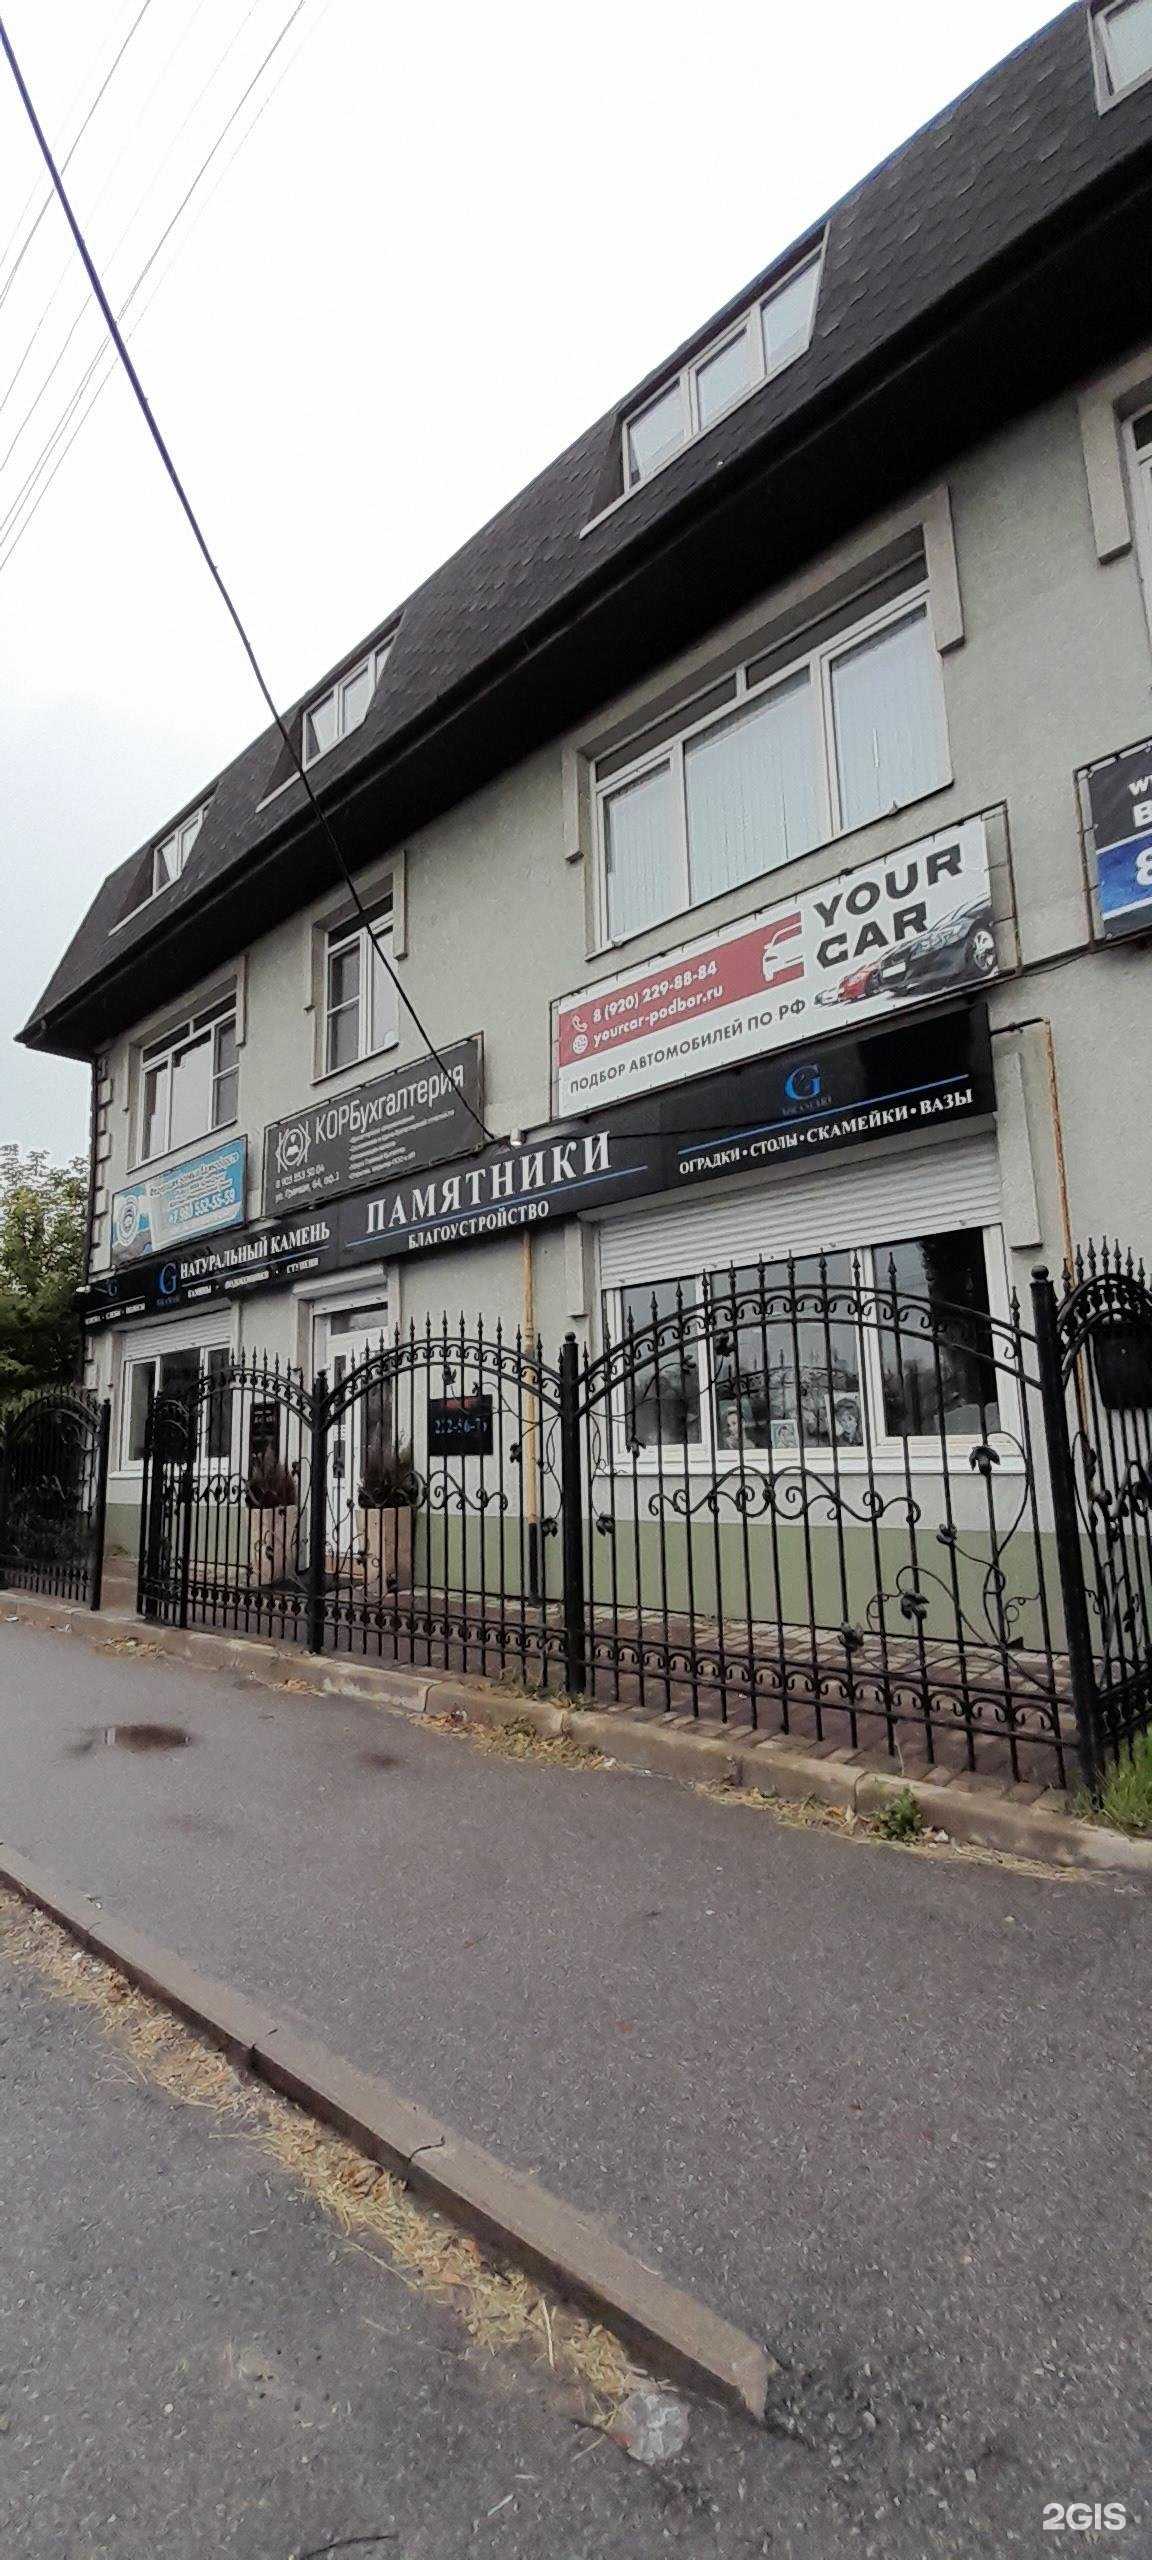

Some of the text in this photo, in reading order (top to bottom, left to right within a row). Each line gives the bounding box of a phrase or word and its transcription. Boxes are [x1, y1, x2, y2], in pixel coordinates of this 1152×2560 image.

[813, 843, 963, 928] YOUR
[817, 901, 928, 969] CAR
[592, 960, 719, 1024] 8 (920) 229-88-84
[593, 984, 724, 1047] yourcar-podbor.ru
[570, 998, 806, 1094] ПОДБОР АВТОМОБИЛЕЙ ПО РФ
[316, 1064, 464, 1144] КОРБухгалтерия
[679, 1148, 741, 1175] ОГРАДКИ
[750, 1134, 799, 1157] СТОЛЫ
[806, 1105, 908, 1143] СКАМЕЙКИ
[920, 1088, 974, 1115] ВАЗЫ
[366, 1130, 612, 1234] ПАМЯТНИКИ
[180, 1221, 331, 1280] НАТУРАЛЬНЫЙ КАМЕНЬ
[408, 1200, 549, 1249] БЛАГОУСТРОЙСТВО
